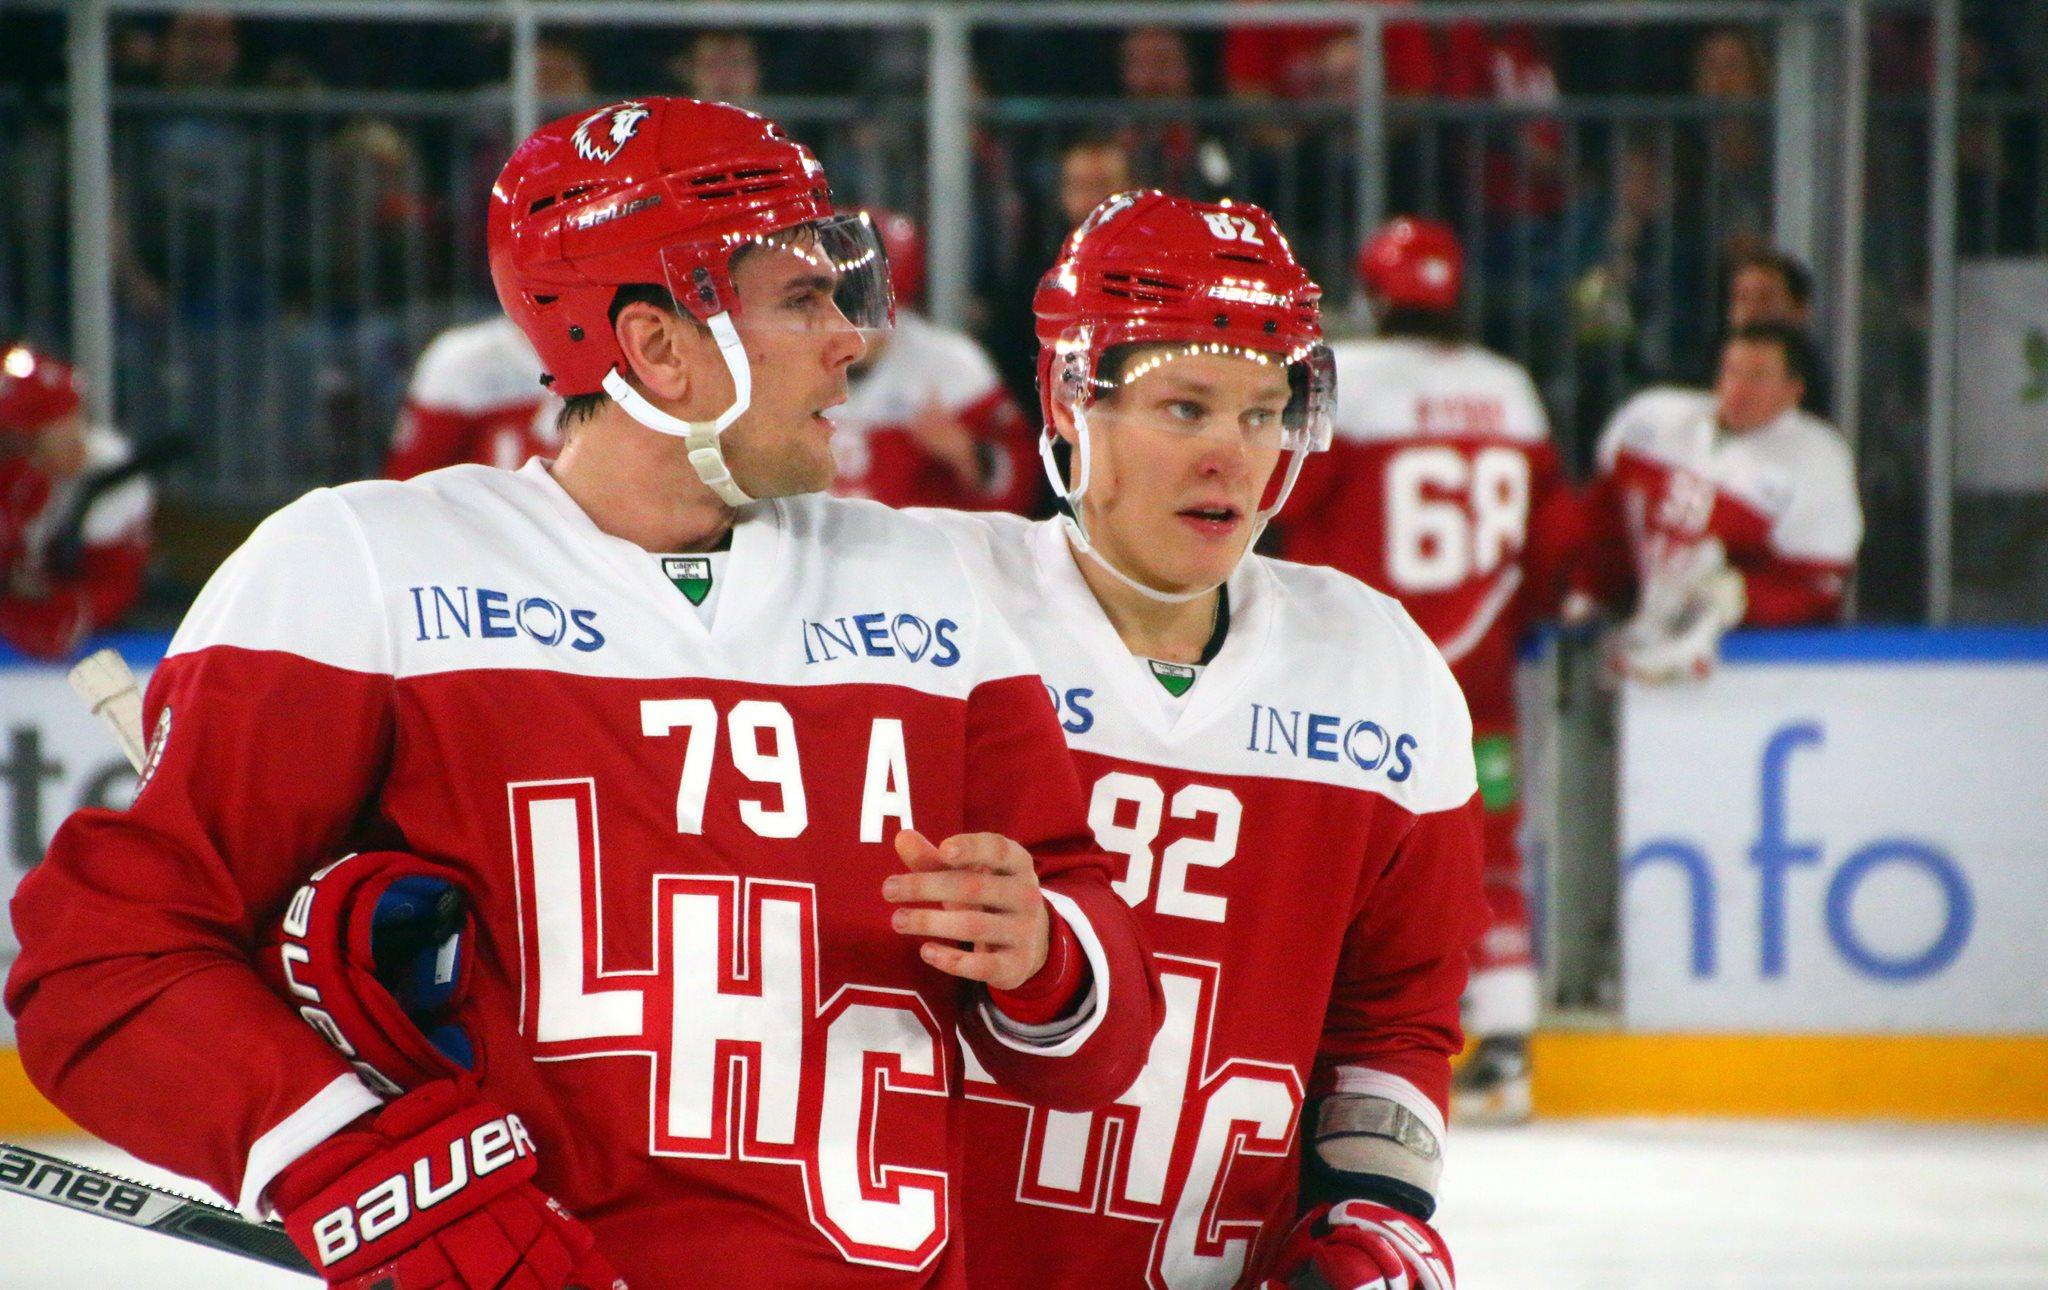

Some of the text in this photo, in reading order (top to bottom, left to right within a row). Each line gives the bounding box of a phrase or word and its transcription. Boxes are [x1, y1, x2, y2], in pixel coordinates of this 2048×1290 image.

[1203, 212, 1265, 246] 82
[408, 585, 606, 653] INEOS
[801, 612, 961, 668] INEOS
[639, 698, 914, 843] 79 A
[1246, 703, 1418, 783] INEOS
[507, 776, 950, 1272] LHC
